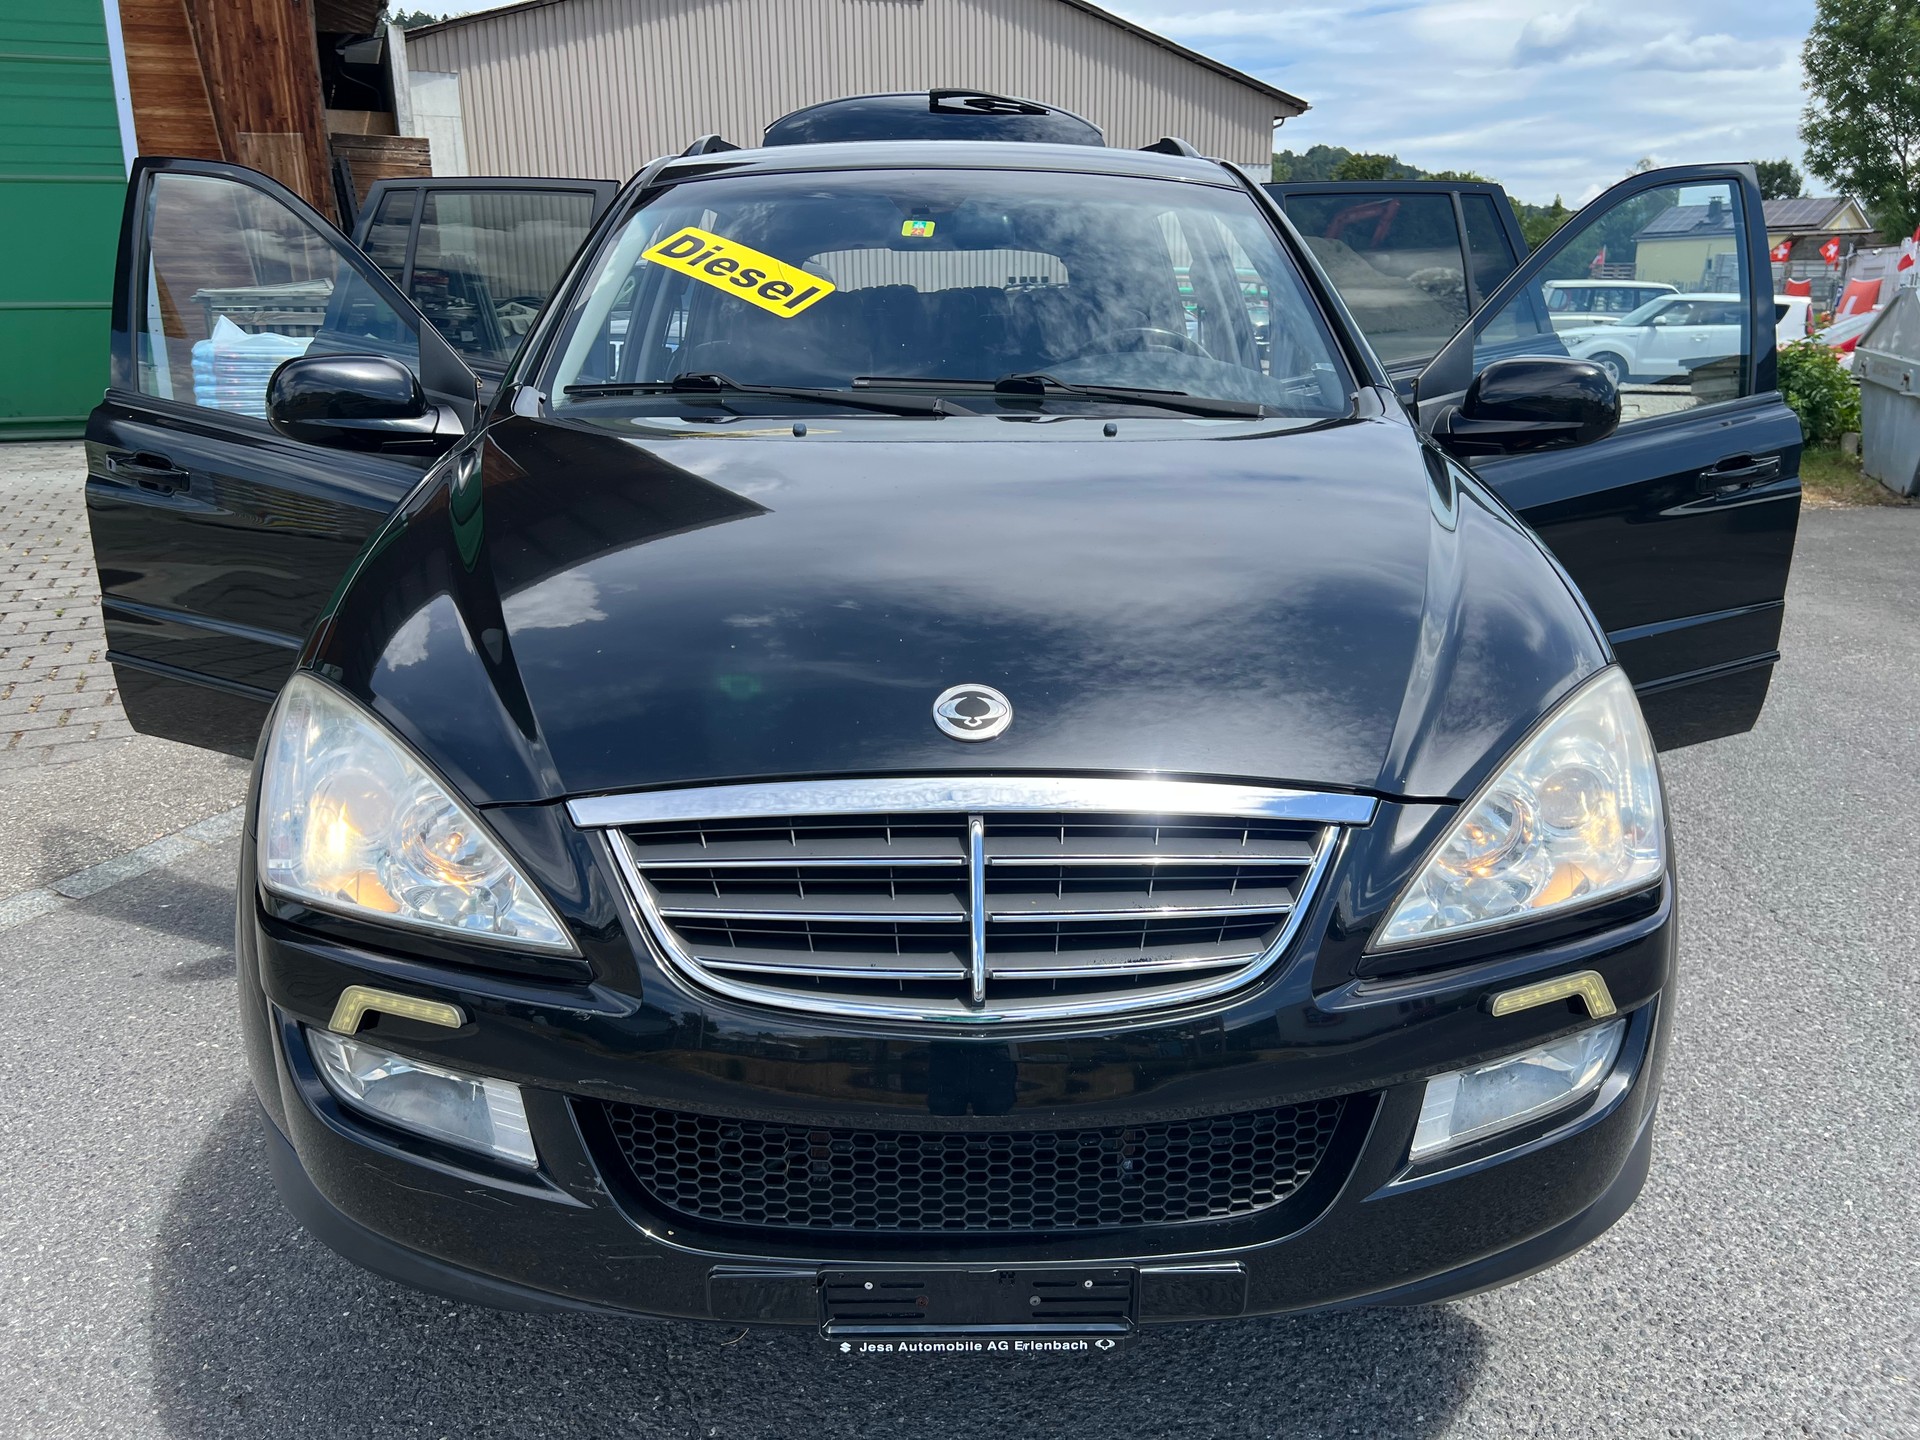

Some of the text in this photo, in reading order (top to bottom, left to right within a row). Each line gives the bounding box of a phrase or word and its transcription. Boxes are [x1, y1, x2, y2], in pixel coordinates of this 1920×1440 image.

[656, 233, 821, 310] Diesel
[859, 1340, 1088, 1352] Jesa Automobile AG Erlenbach
